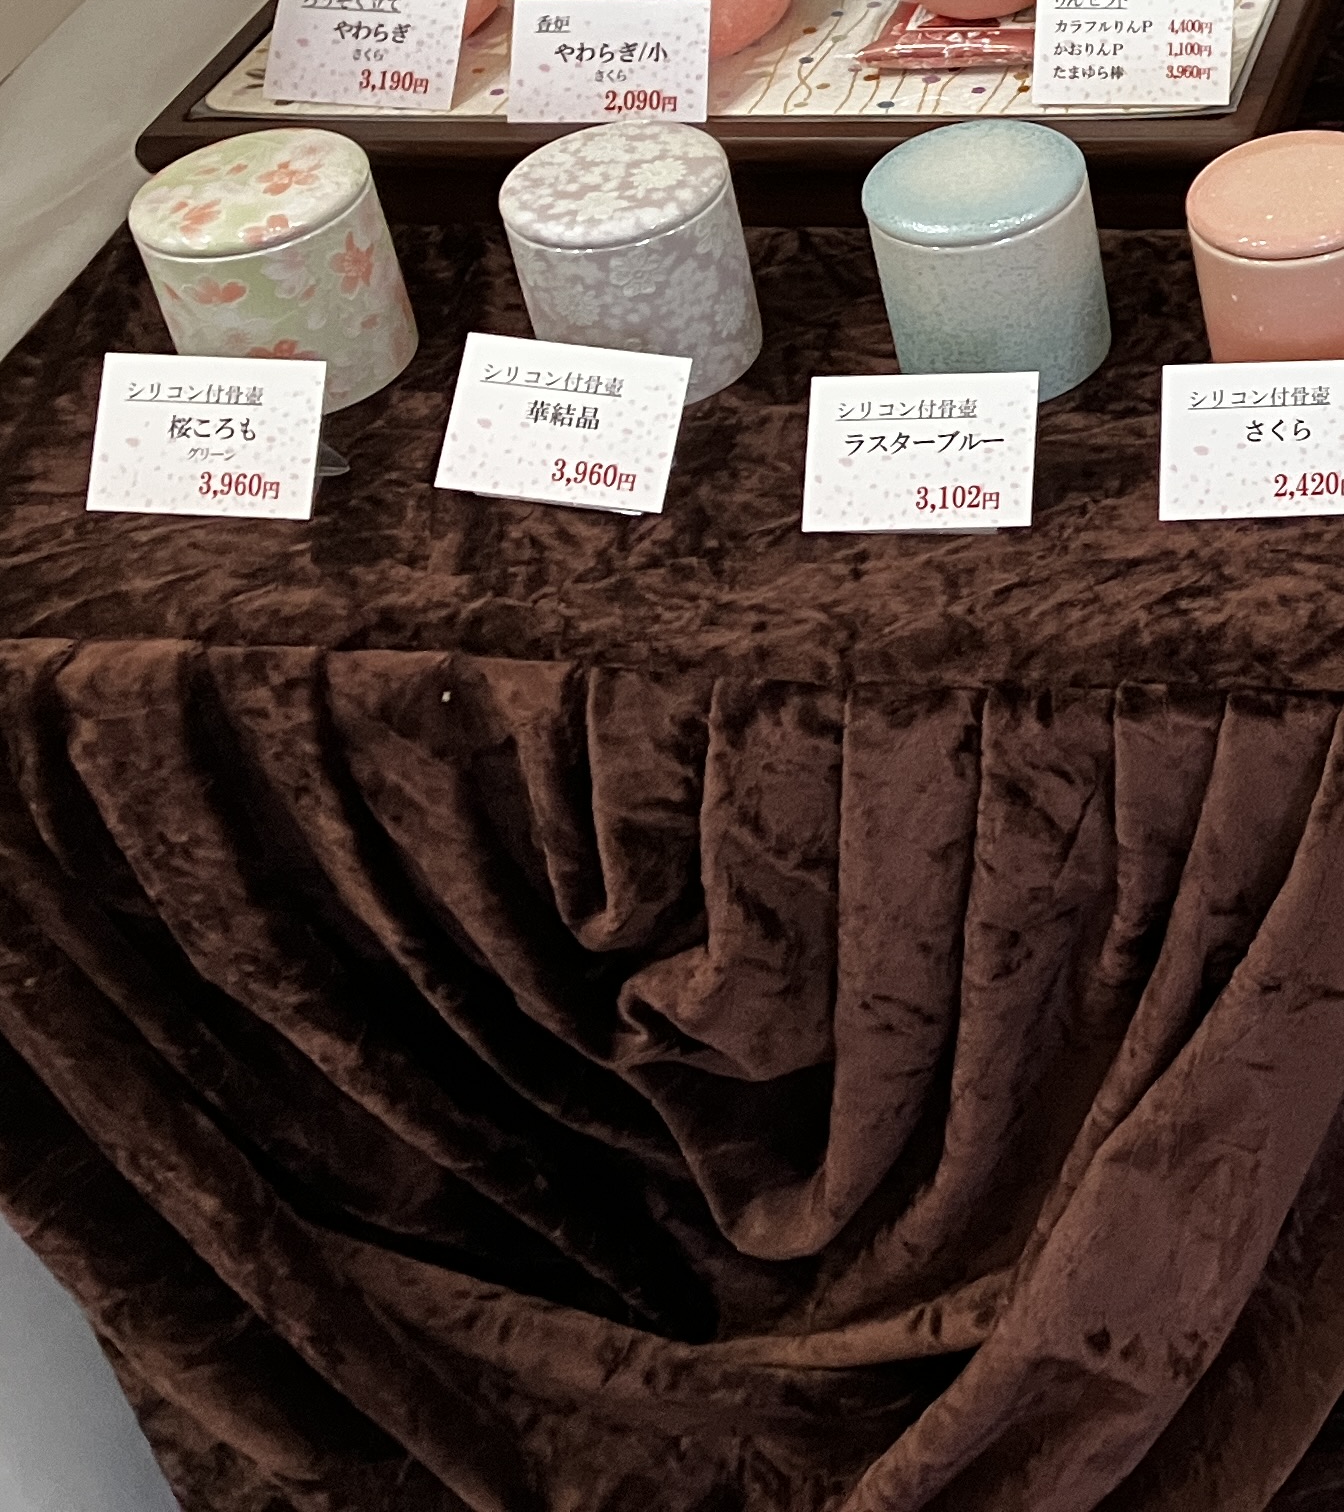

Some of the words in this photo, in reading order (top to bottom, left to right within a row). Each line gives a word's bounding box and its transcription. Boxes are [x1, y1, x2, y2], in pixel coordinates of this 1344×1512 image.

[334, 20, 412, 44] やわらぎ
[1168, 19, 1213, 35] 4,400円
[554, 41, 668, 63] やわらぎ/小
[1053, 43, 1124, 57] かおりんP
[359, 69, 429, 95] 3,190円
[594, 69, 627, 83] さくら
[604, 89, 678, 114] 2,090円
[526, 399, 600, 430] 華結晶
[168, 415, 256, 441] 桜ころも
[1246, 418, 1311, 442] さくら
[187, 447, 236, 460] グリーン
[845, 430, 1005, 456] ラスターブルー
[199, 471, 281, 500] 3,960円
[552, 458, 637, 492] 3,960円
[915, 485, 1000, 513] 3,102円
